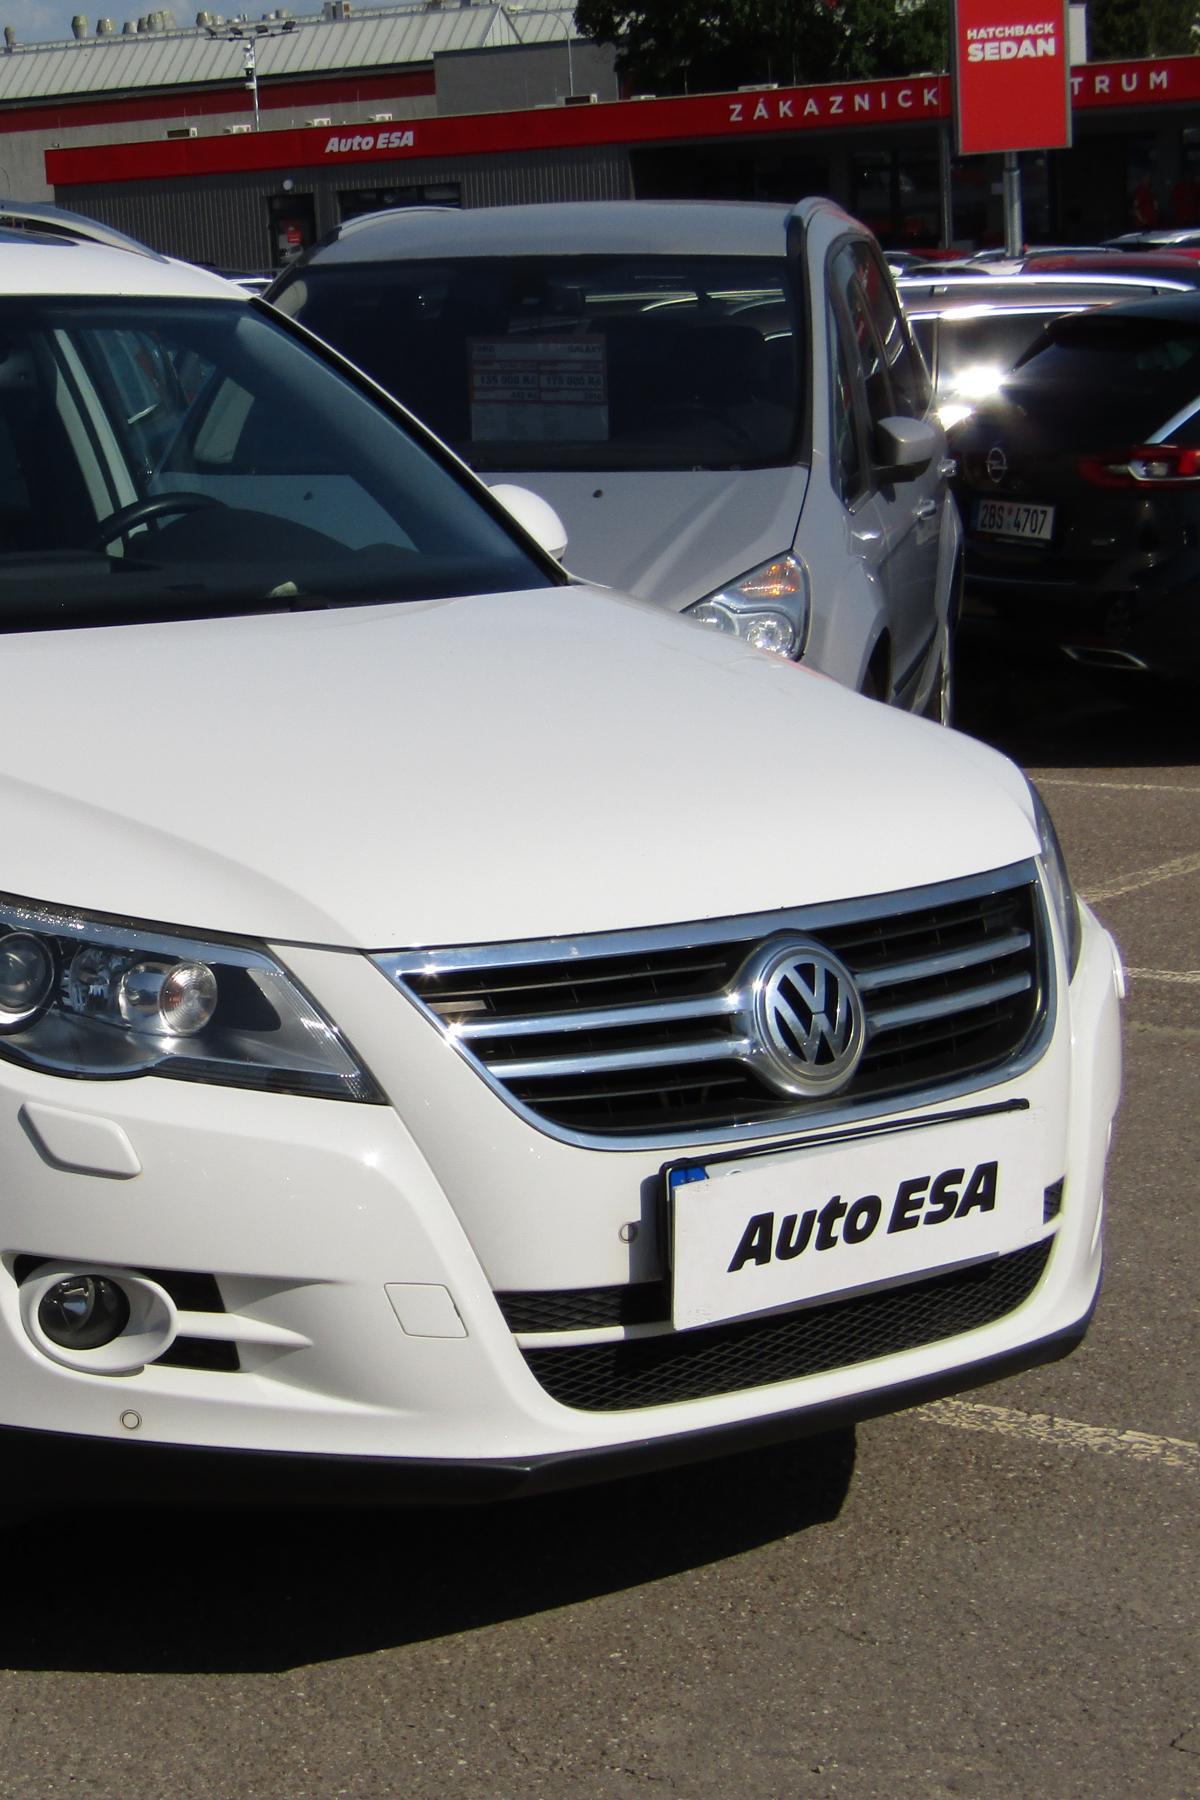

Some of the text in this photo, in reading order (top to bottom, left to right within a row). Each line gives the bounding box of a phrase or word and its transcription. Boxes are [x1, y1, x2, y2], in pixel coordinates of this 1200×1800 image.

[967, 23, 1054, 40] HATCHBACK
[968, 38, 1055, 62] SEDAN
[729, 71, 1168, 122] ZÁKAZNICK TRUM
[325, 131, 414, 153] Auto ESA
[980, 504, 1048, 535] 2BS 4707
[727, 1160, 999, 1273] Auto ESA
